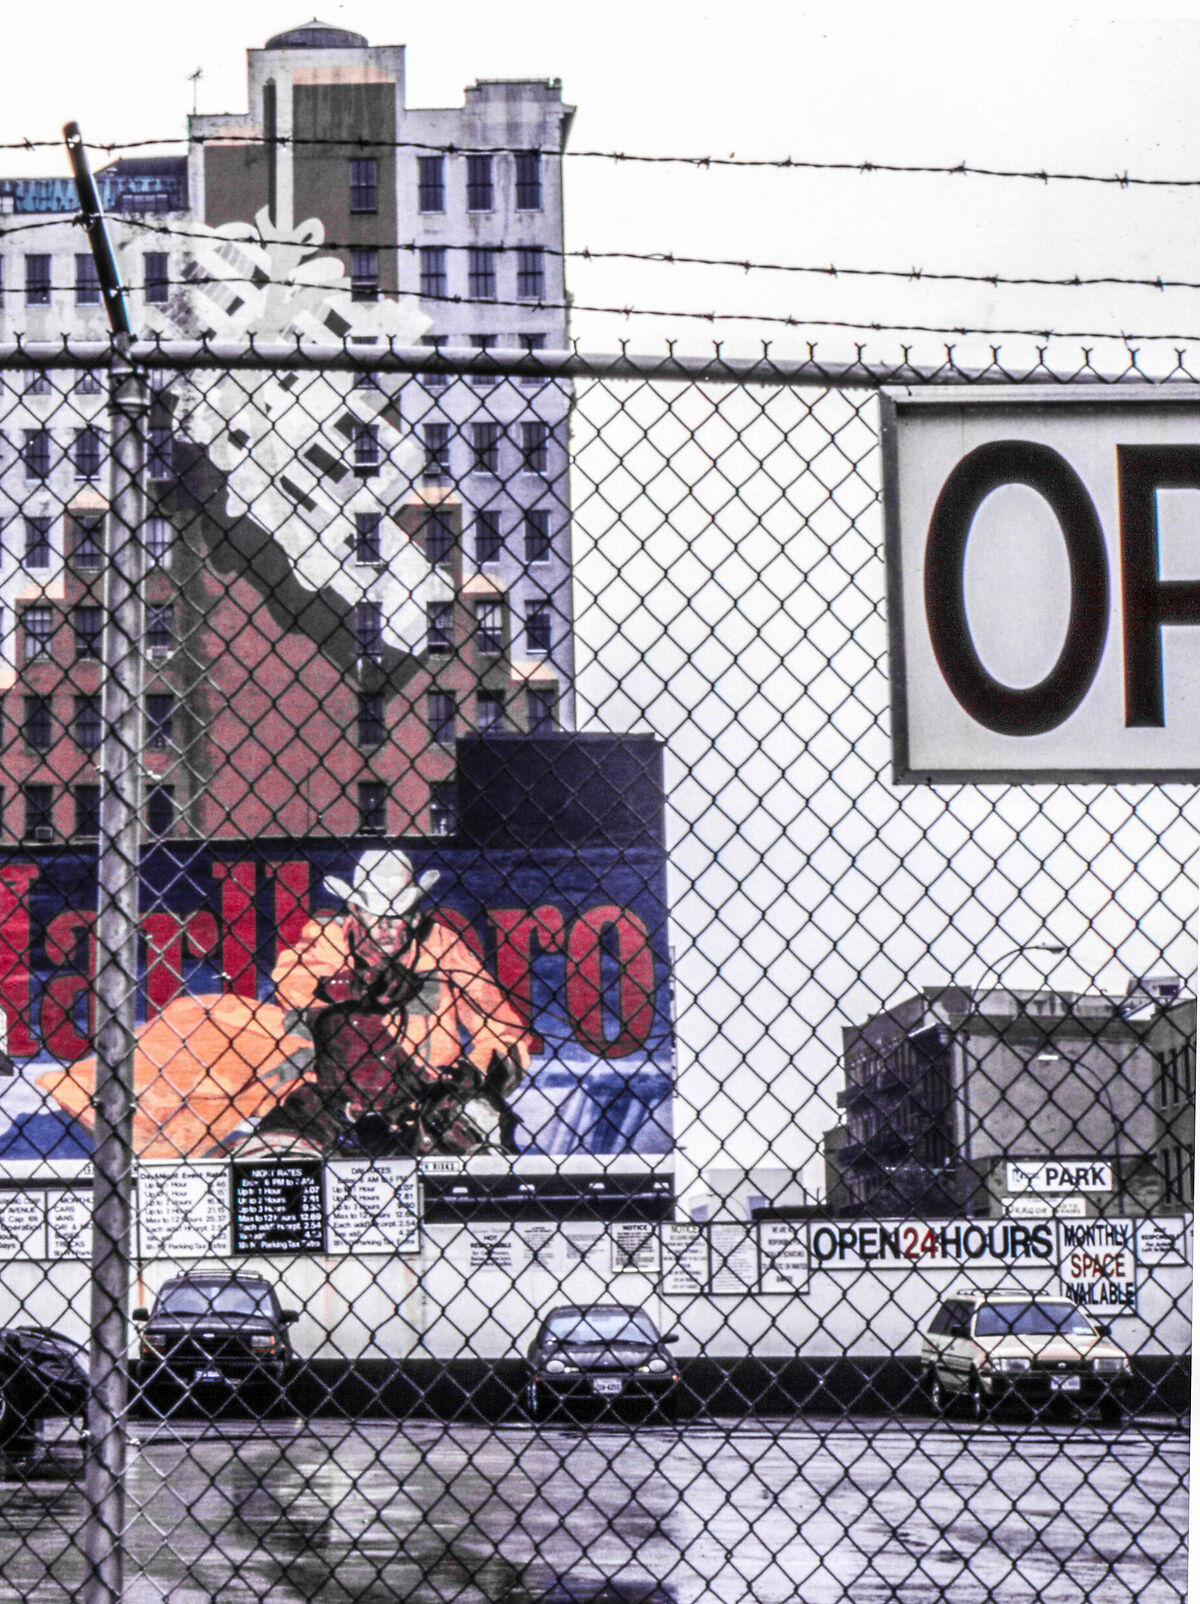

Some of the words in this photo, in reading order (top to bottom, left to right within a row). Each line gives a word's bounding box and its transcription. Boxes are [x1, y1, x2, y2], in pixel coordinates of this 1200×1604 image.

[251, 1169, 275, 1177] NIGT
[1045, 1167, 1106, 1186] PARK
[263, 1187, 282, 1195] Hour
[273, 1214, 297, 1222] Hurs
[813, 1227, 900, 1261] OPEN
[903, 1227, 938, 1259] 24
[941, 1224, 1053, 1259] HOURS
[1064, 1224, 1128, 1246] MONTHLY
[260, 1241, 288, 1250] Parking
[1070, 1253, 1126, 1278] SPACE
[1066, 1282, 1134, 1305] AVAILABLE
